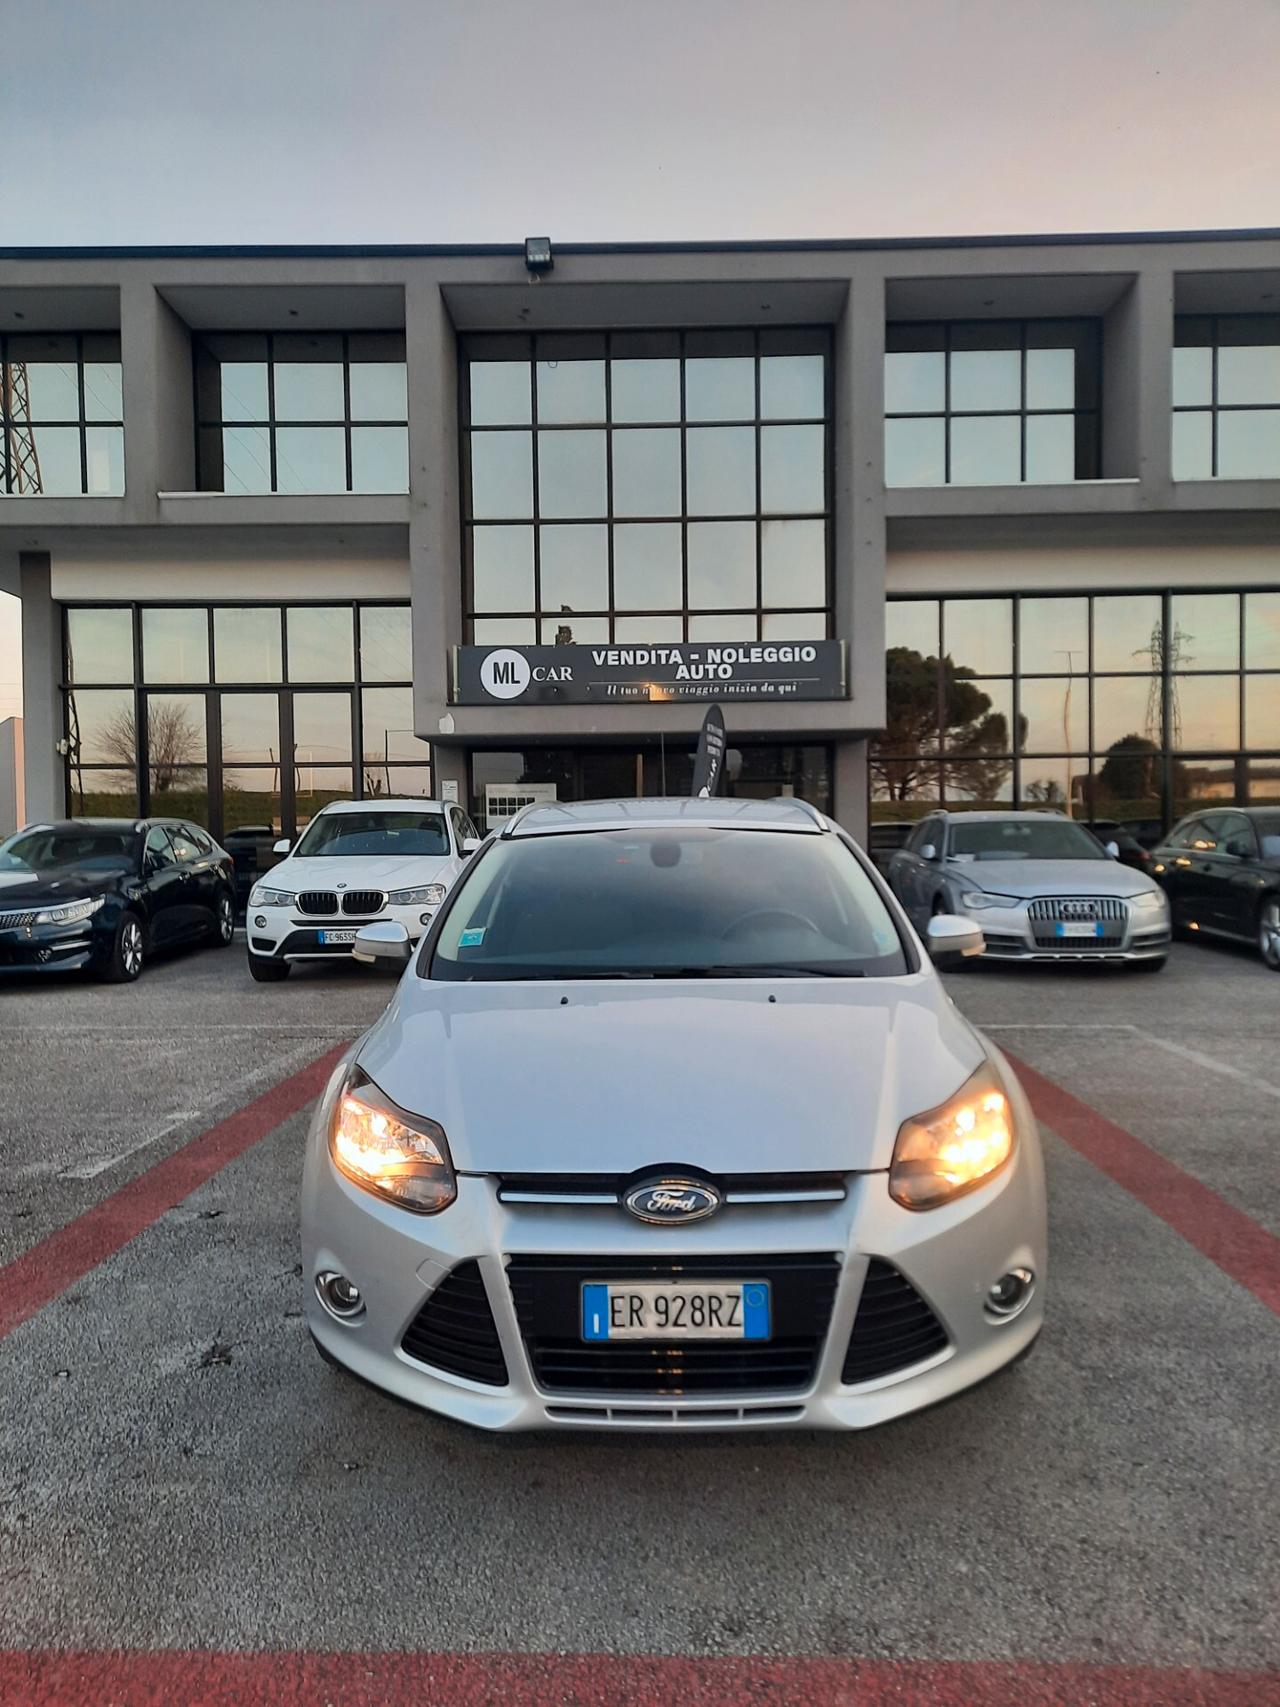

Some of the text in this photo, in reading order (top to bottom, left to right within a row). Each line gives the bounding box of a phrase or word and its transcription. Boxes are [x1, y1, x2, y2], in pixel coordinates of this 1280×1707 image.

[592, 649, 684, 666] VENDITA
[707, 646, 817, 664] NOLEGGIO
[493, 661, 573, 685] ML CAR
[675, 664, 733, 680] AUTO
[620, 686, 638, 695] tuo
[642, 685, 675, 694] novo
[679, 684, 720, 696] viaggio
[723, 683, 757, 693] inizia
[761, 682, 775, 692] da
[778, 682, 798, 695] qui
[647, 1190, 696, 1212] Ford
[610, 1295, 644, 1328] ER
[654, 1295, 743, 1328] 928RZ
